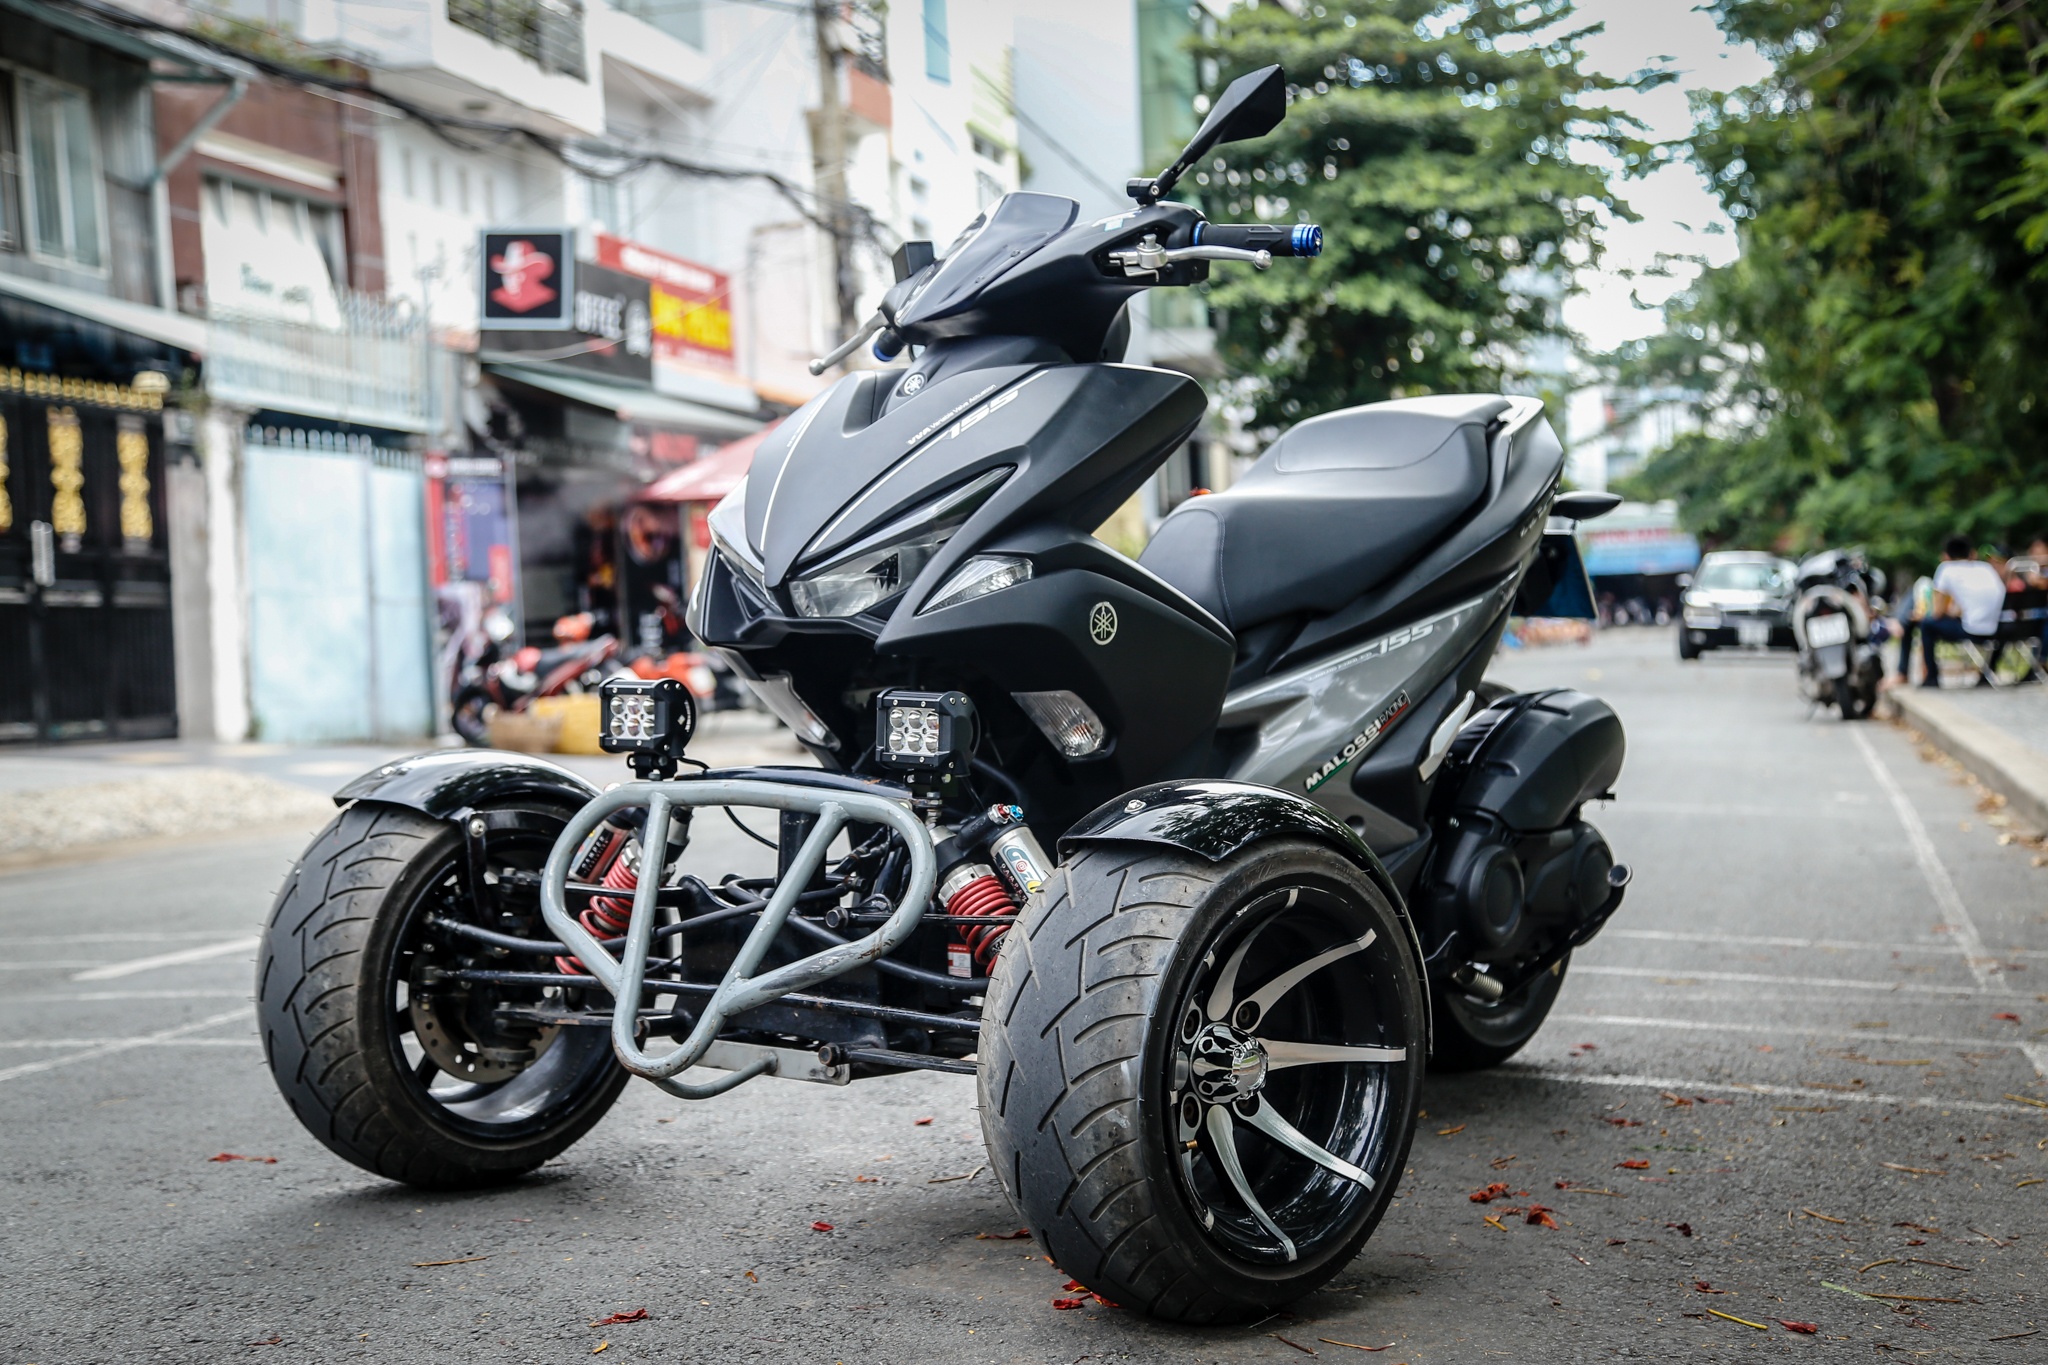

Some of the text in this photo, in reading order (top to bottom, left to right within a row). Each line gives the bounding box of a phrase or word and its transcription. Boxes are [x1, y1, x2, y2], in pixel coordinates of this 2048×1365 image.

[948, 389, 1019, 439] 155
[907, 426, 931, 444] VVA
[1379, 622, 1434, 655] 155
[1305, 694, 1407, 790] MALOSSI RACING
